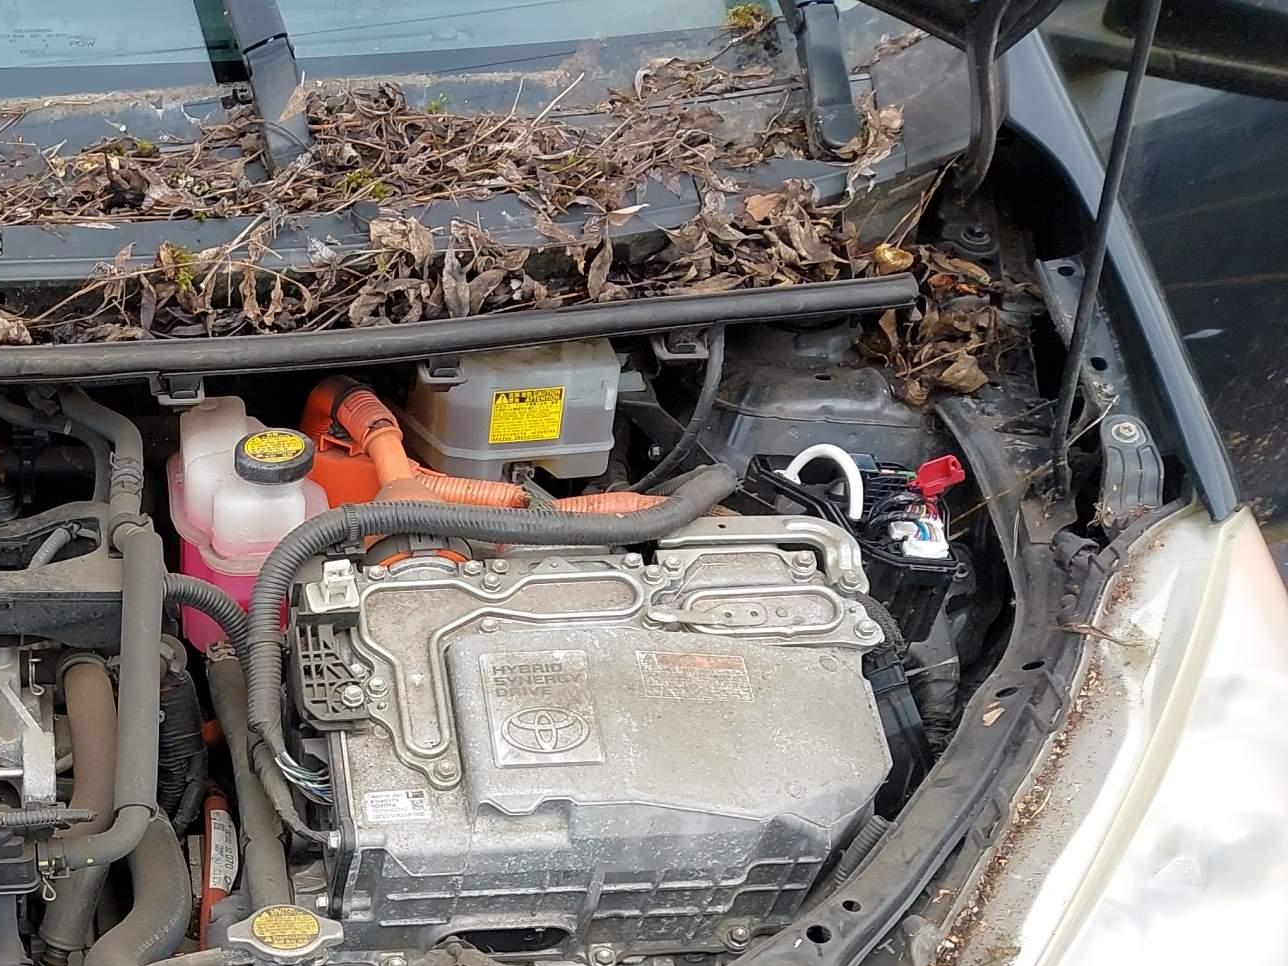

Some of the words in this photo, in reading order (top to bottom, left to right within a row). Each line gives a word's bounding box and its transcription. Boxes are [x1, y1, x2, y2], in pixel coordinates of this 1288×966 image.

[492, 663, 563, 675] HYBRID
[493, 673, 582, 686] SYNERGY
[495, 686, 553, 697] DRIVE
